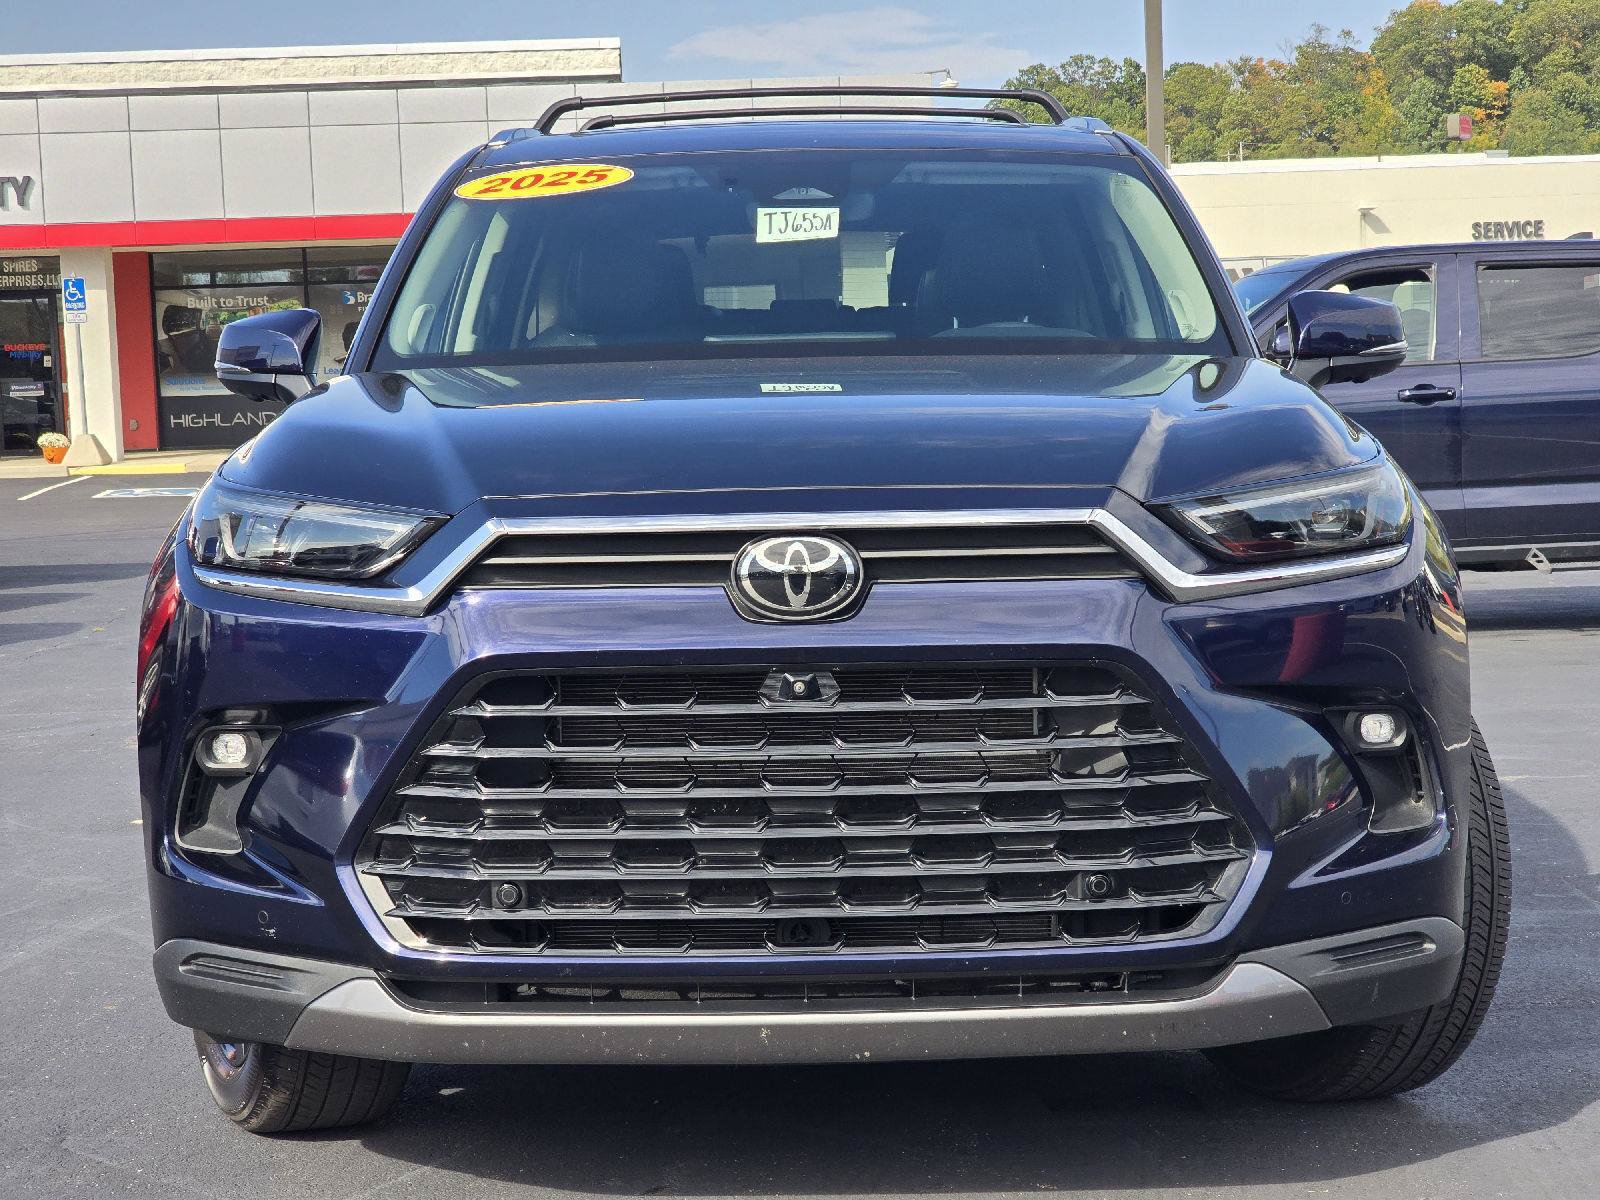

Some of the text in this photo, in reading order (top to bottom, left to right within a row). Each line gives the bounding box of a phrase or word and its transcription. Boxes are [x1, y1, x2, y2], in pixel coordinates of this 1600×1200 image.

[472, 168, 614, 196] 2025
[763, 210, 837, 235] TJ655A
[1471, 219, 1545, 240] SERVICE
[2, 259, 38, 273] SPIRES
[187, 294, 269, 309] Built to Trust
[4, 343, 47, 352] BUCKEYE
